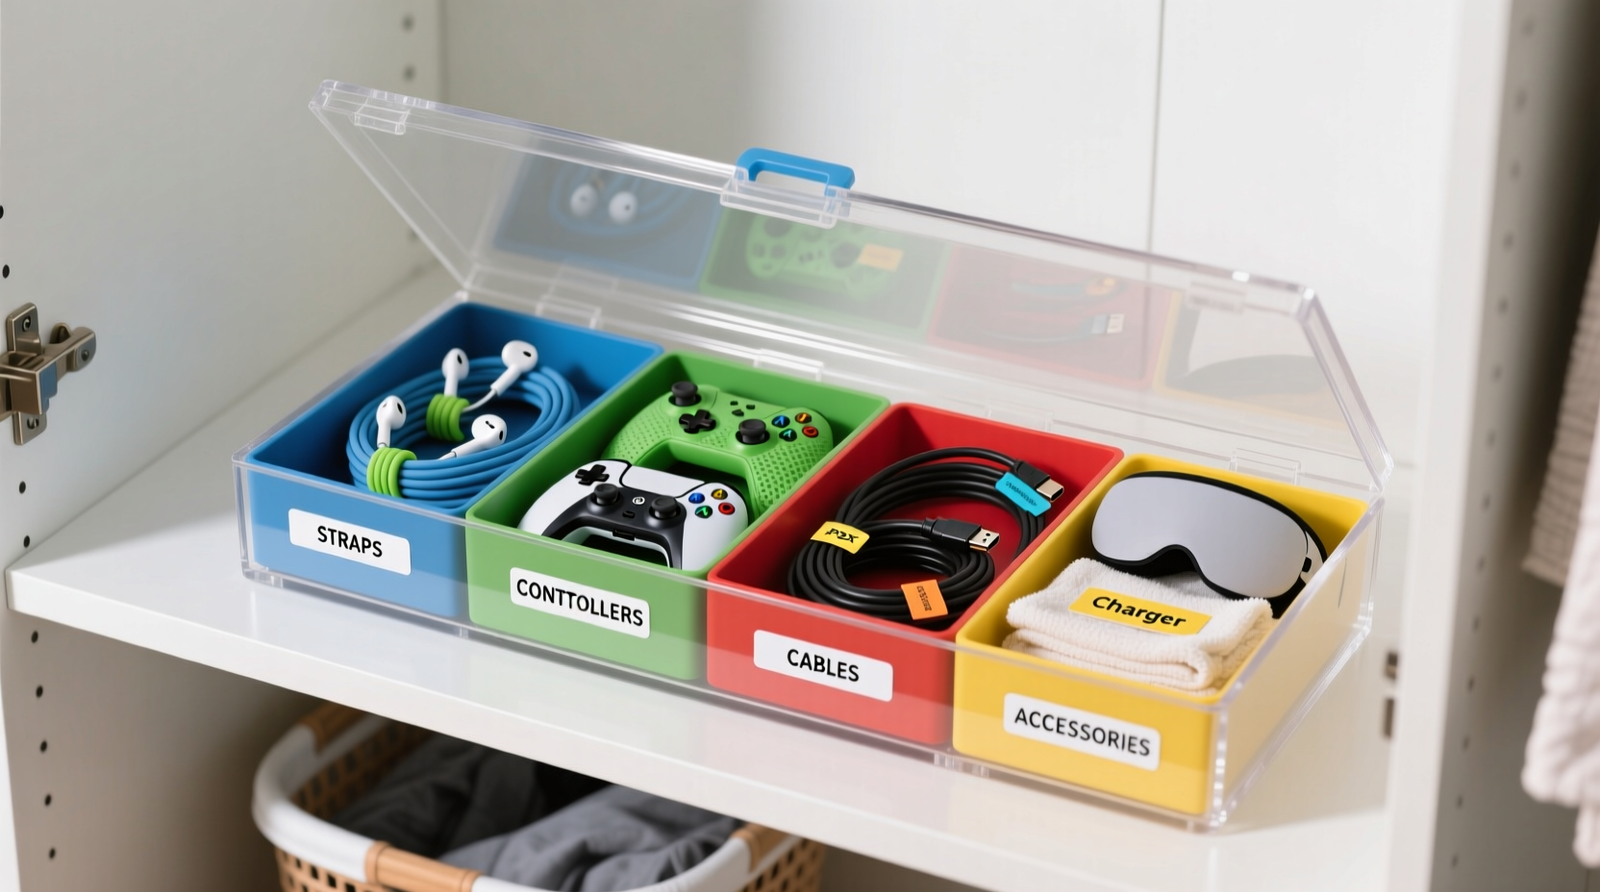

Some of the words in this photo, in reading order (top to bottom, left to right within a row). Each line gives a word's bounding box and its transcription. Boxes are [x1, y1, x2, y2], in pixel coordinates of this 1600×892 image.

[317, 525, 383, 558] STRAPS
[516, 578, 644, 627] CONTTOLLERS
[1092, 596, 1187, 627] Charger
[787, 649, 860, 682] CABLES
[1014, 708, 1151, 756] ACCESSORIES
